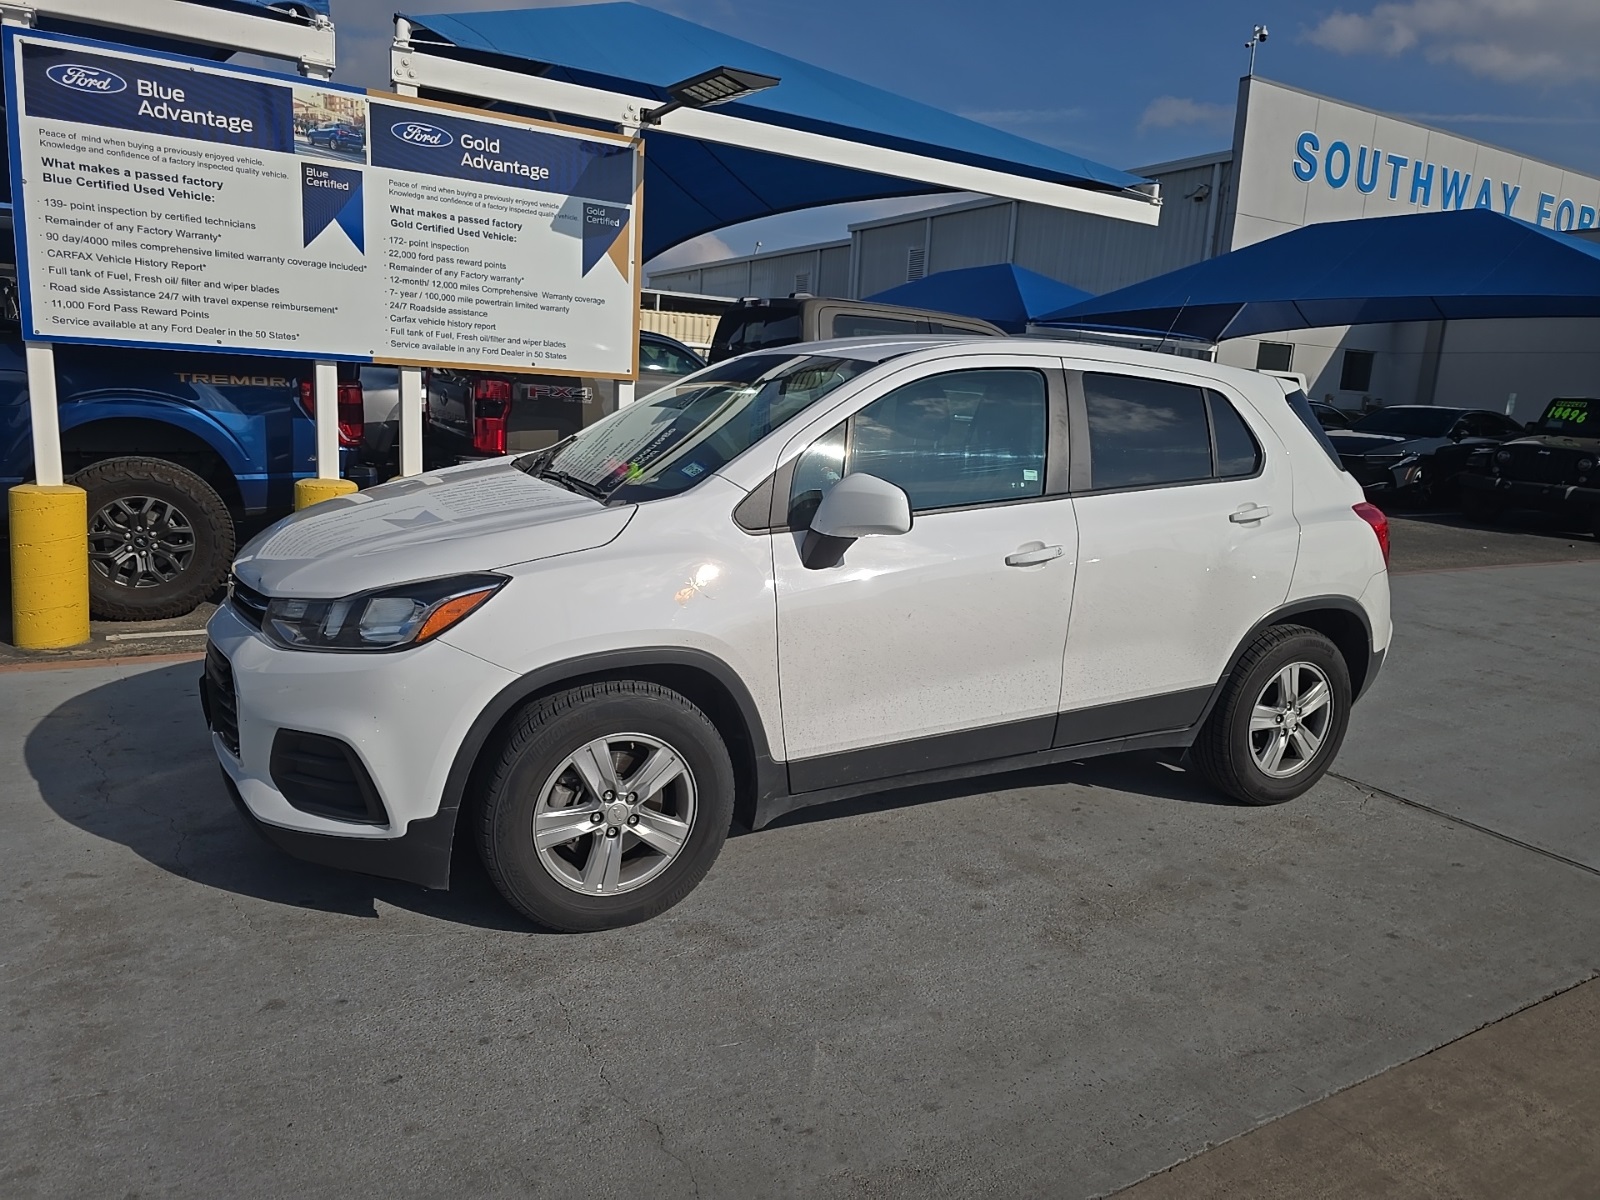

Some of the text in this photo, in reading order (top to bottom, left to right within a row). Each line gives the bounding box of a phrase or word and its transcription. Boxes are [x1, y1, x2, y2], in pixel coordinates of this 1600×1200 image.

[62, 67, 111, 90] Ford
[137, 79, 185, 103] Blue
[138, 100, 253, 133] Advantage
[403, 125, 441, 145] Ford
[460, 134, 500, 154] Gold
[38, 128, 264, 166] Peace mind when buying previously enjoyed vehicle.
[39, 138, 86, 152] Knowledge
[106, 149, 149, 160] confidence
[168, 156, 195, 167] factory
[197, 160, 233, 172] inspected
[235, 166, 259, 176] quality
[261, 170, 288, 179] vehicle.
[40, 156, 223, 190] What makes a passed factory
[306, 167, 328, 178] Blue
[460, 152, 549, 181] Advantage
[42, 172, 214, 202] Blue Certified Used Vehicle:
[306, 177, 349, 190] Certified
[1292, 130, 1600, 232] SOUTHWAY FOR
[43, 198, 256, 229] 139- point inspection by certified technicians
[390, 204, 414, 215] What
[417, 210, 447, 219] makes
[457, 215, 489, 225] passed
[492, 218, 522, 231] factory
[586, 206, 606, 216] Gold
[586, 215, 620, 227] Certified
[44, 214, 100, 228] Remainder
[103, 221, 112, 229] of
[116, 224, 133, 233] any
[137, 224, 173, 238] Factory
[390, 218, 516, 242] Gold Certified Used Vehicle:
[45, 231, 59, 241] 90
[61, 233, 108, 246] day/4000
[111, 239, 137, 248] miles
[139, 243, 212, 256] comprehensive
[214, 248, 244, 259] limited
[246, 254, 285, 265] warranty
[287, 258, 327, 269] coverage
[389, 236, 469, 252] 172- point inspection
[46, 248, 92, 261] CARFAX
[95, 253, 131, 264] Vehicle
[134, 256, 168, 269] History
[389, 249, 416, 259] 22,000
[418, 252, 433, 261] ford
[456, 258, 482, 267] reward
[484, 261, 506, 269] points
[48, 265, 67, 275] Full
[69, 268, 91, 277] tank
[93, 270, 103, 278] of
[106, 270, 131, 281] Fuel,
[134, 272, 162, 283] Fresh
[164, 276, 178, 284] oil/
[181, 277, 201, 286] filter
[223, 282, 248, 292] wiper
[250, 283, 279, 293] blades
[390, 262, 432, 273] Remainder
[434, 267, 442, 275] of
[444, 270, 458, 278] any
[460, 270, 488, 281] Factory
[49, 282, 76, 292] Road
[79, 285, 100, 294] side
[102, 286, 155, 298] Assistance
[158, 291, 179, 300] 24/7
[181, 293, 200, 302] with
[203, 295, 228, 304] travel
[231, 299, 268, 308] expense
[399, 290, 417, 298] year
[424, 292, 455, 302] 100,000
[475, 298, 513, 307] powertrain
[515, 301, 538, 309] limited
[539, 304, 569, 314] warranty
[432, 280, 458, 289] 12,000
[459, 283, 479, 292] miles
[481, 285, 537, 297] Comprehensive
[541, 291, 572, 302] Warranty
[574, 296, 605, 305] coverage
[51, 299, 209, 318] 11,000 Ford Pass Reward Points
[390, 301, 488, 317] 24/7 Roadside assistance
[51, 315, 89, 326] Service
[92, 319, 136, 329] available
[138, 322, 148, 330] at
[150, 324, 168, 333] any
[171, 323, 192, 333] Ford
[195, 325, 226, 335] Dealer
[228, 328, 236, 336] in
[238, 329, 252, 337] the
[255, 330, 266, 338] 50
[390, 314, 496, 330] Carfax vehicle history report
[390, 326, 404, 335] Full
[406, 328, 423, 336] tank
[435, 330, 454, 339] Fuel,
[456, 332, 478, 341] Fresh
[522, 338, 541, 347] wiper
[543, 339, 566, 348] blades
[390, 339, 567, 359] Service available any Ford Dealer 50 States
[173, 372, 290, 387] TREMOR
[521, 384, 593, 402] FX4
